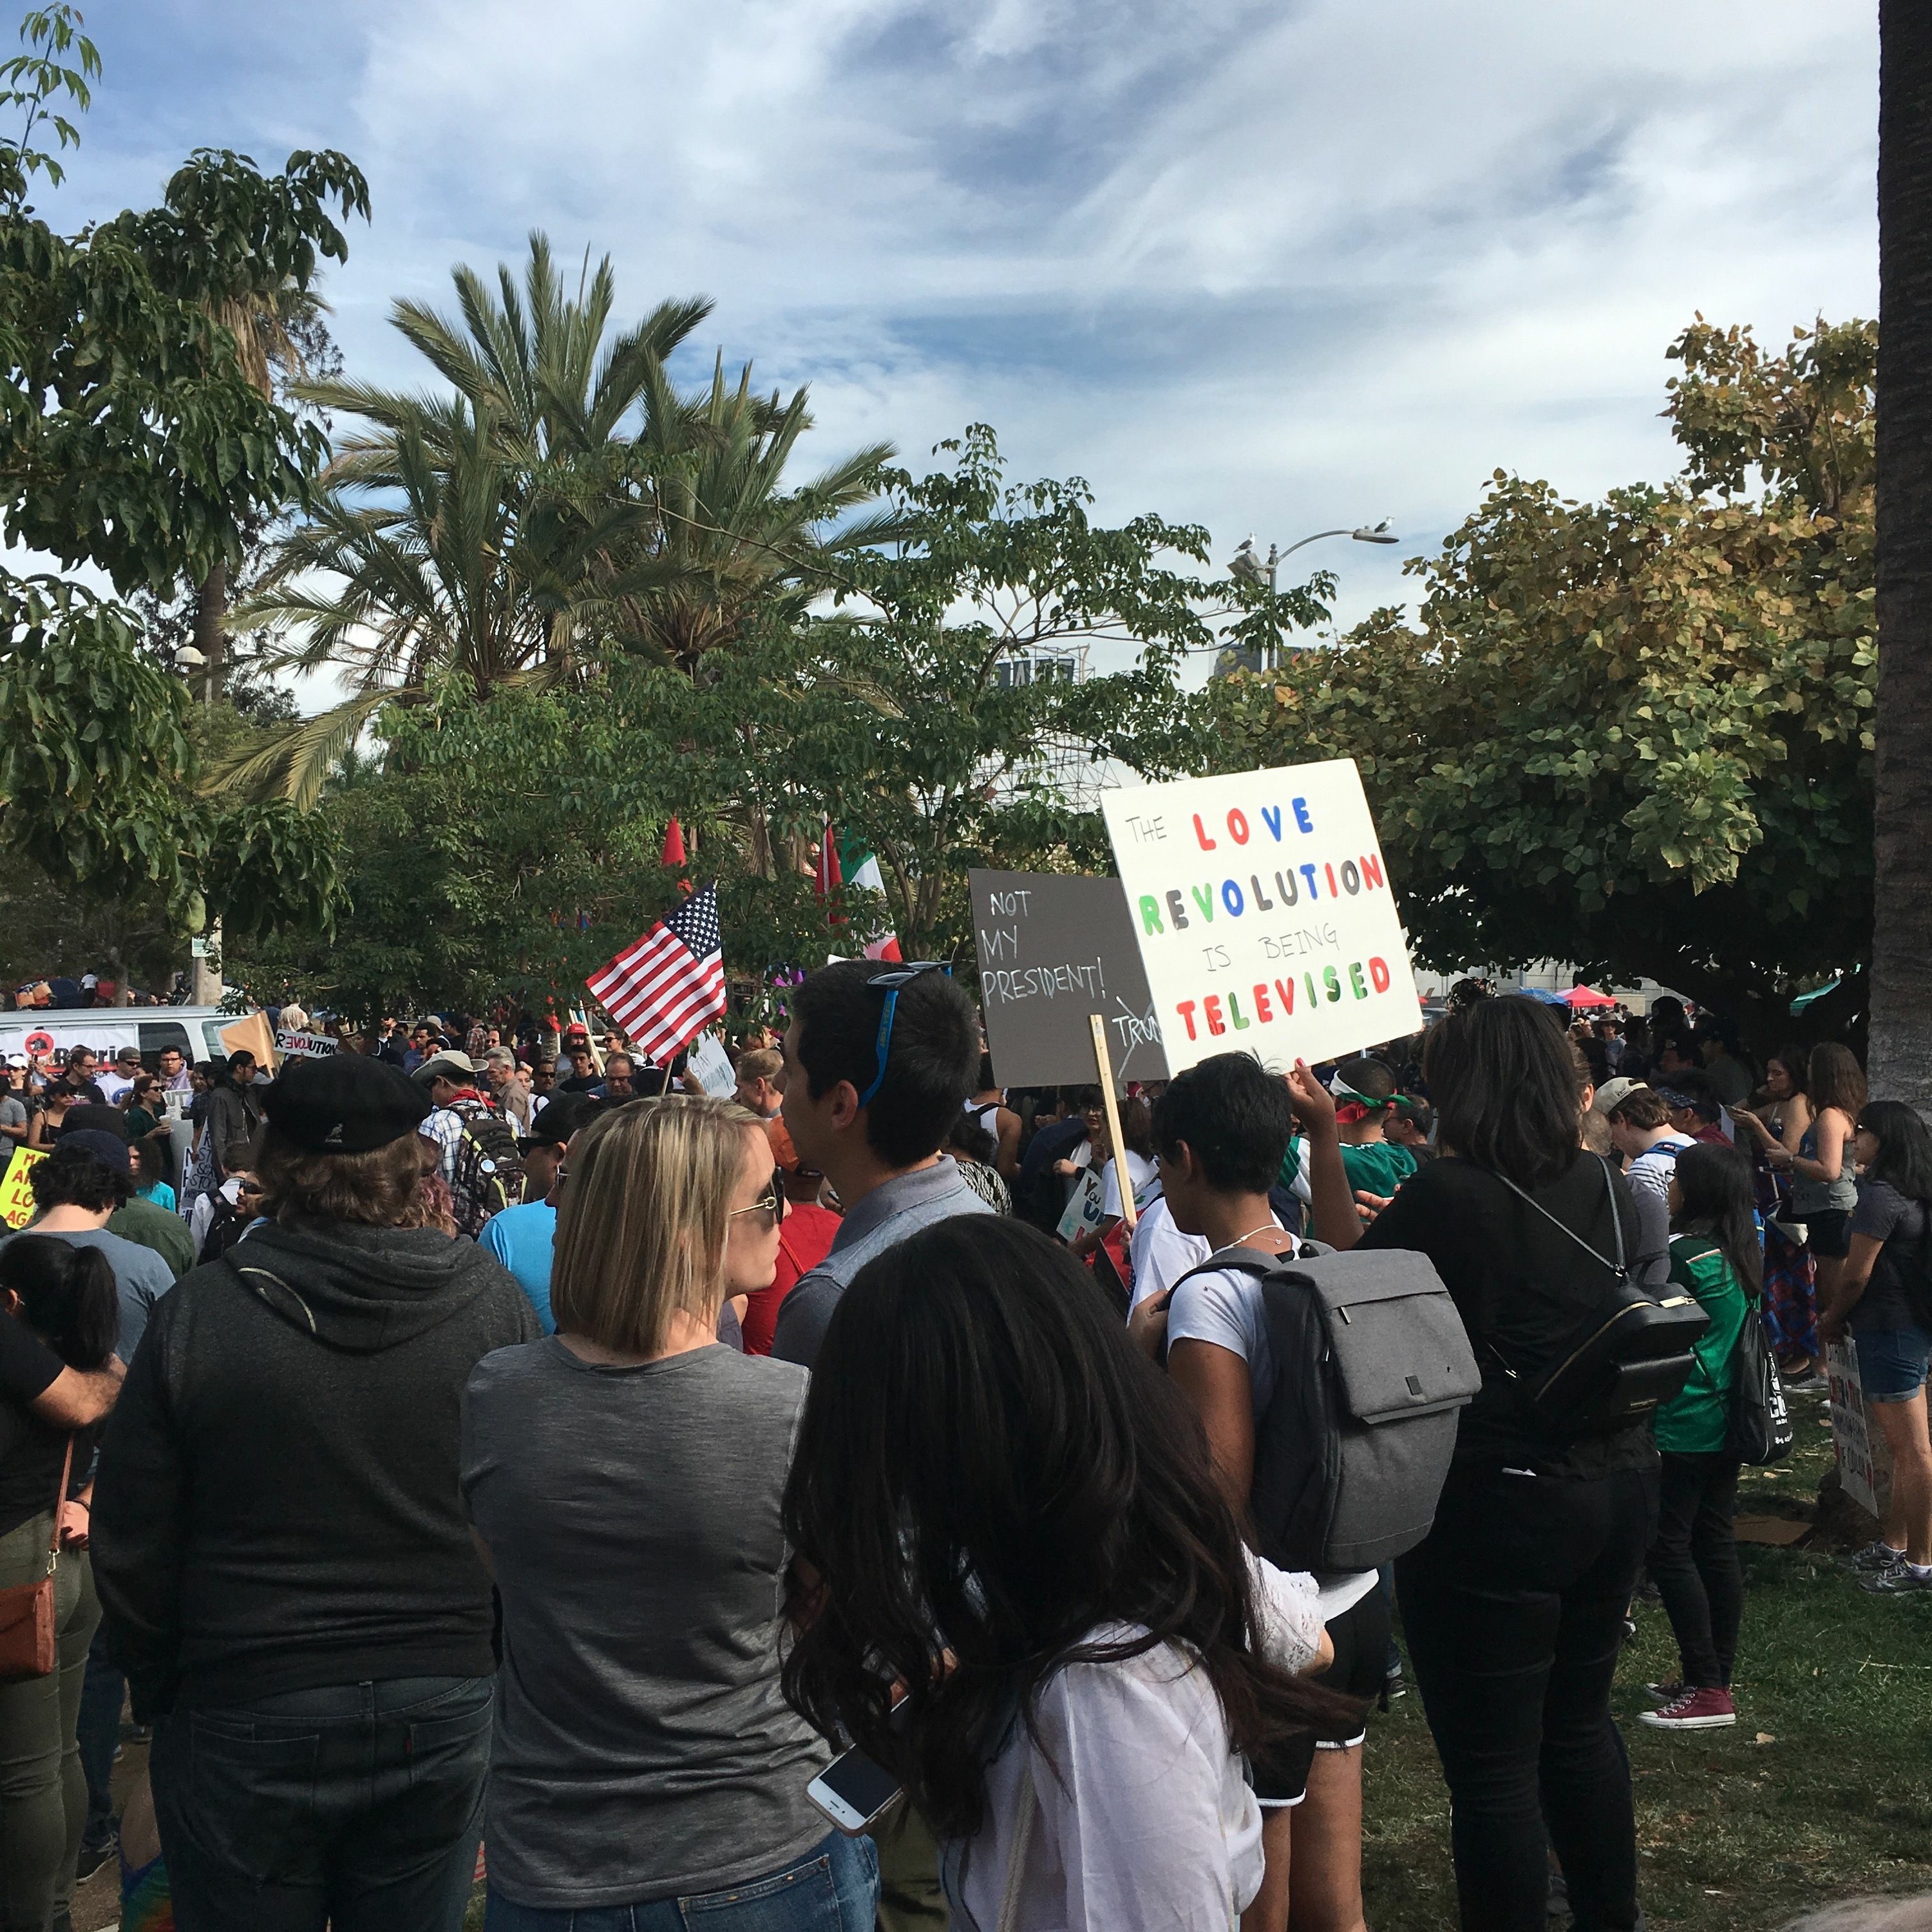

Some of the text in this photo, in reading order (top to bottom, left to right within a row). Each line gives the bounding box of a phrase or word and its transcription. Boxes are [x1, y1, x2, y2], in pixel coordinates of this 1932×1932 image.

[1126, 797, 1314, 851] THE LOVE
[990, 891, 1031, 917] NOT
[1139, 854, 1384, 936] REVOLUTION
[982, 925, 1018, 964] MY
[1202, 923, 1340, 971] IS BEING
[982, 956, 1106, 1007] PRESIDENT!
[1177, 956, 1390, 1041] TELEVISED
